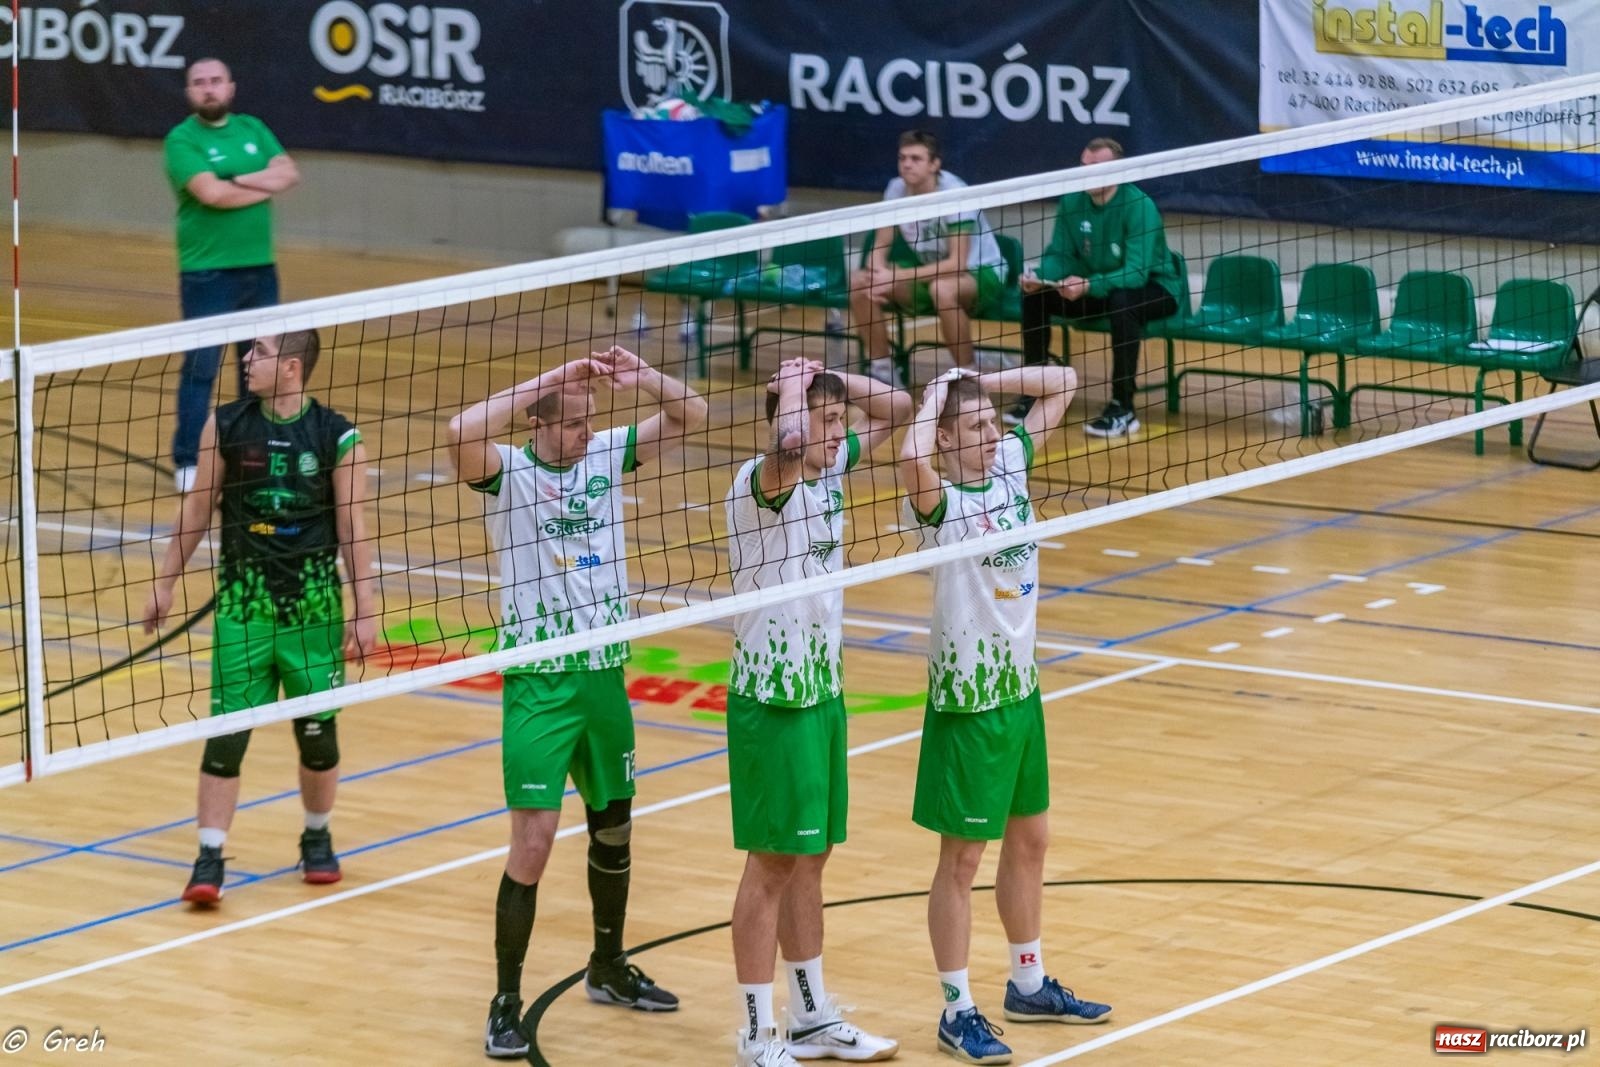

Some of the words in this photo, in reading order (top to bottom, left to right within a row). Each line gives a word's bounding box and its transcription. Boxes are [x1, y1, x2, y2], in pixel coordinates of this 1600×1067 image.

[309, 0, 486, 83] OSiR
[1313, 0, 1567, 58] instal-tech
[379, 83, 486, 112] RACIBÓRZ
[788, 43, 1131, 127] RACIBÓRZ
[1301, 70, 1320, 86] 32
[1324, 71, 1354, 88] 414
[1406, 77, 1433, 93] 502
[1438, 79, 1466, 95] 632
[1288, 93, 1340, 112] 47-400
[1356, 150, 1525, 181] www.instal-tech.pl
[1020, 953, 1036, 965] R
